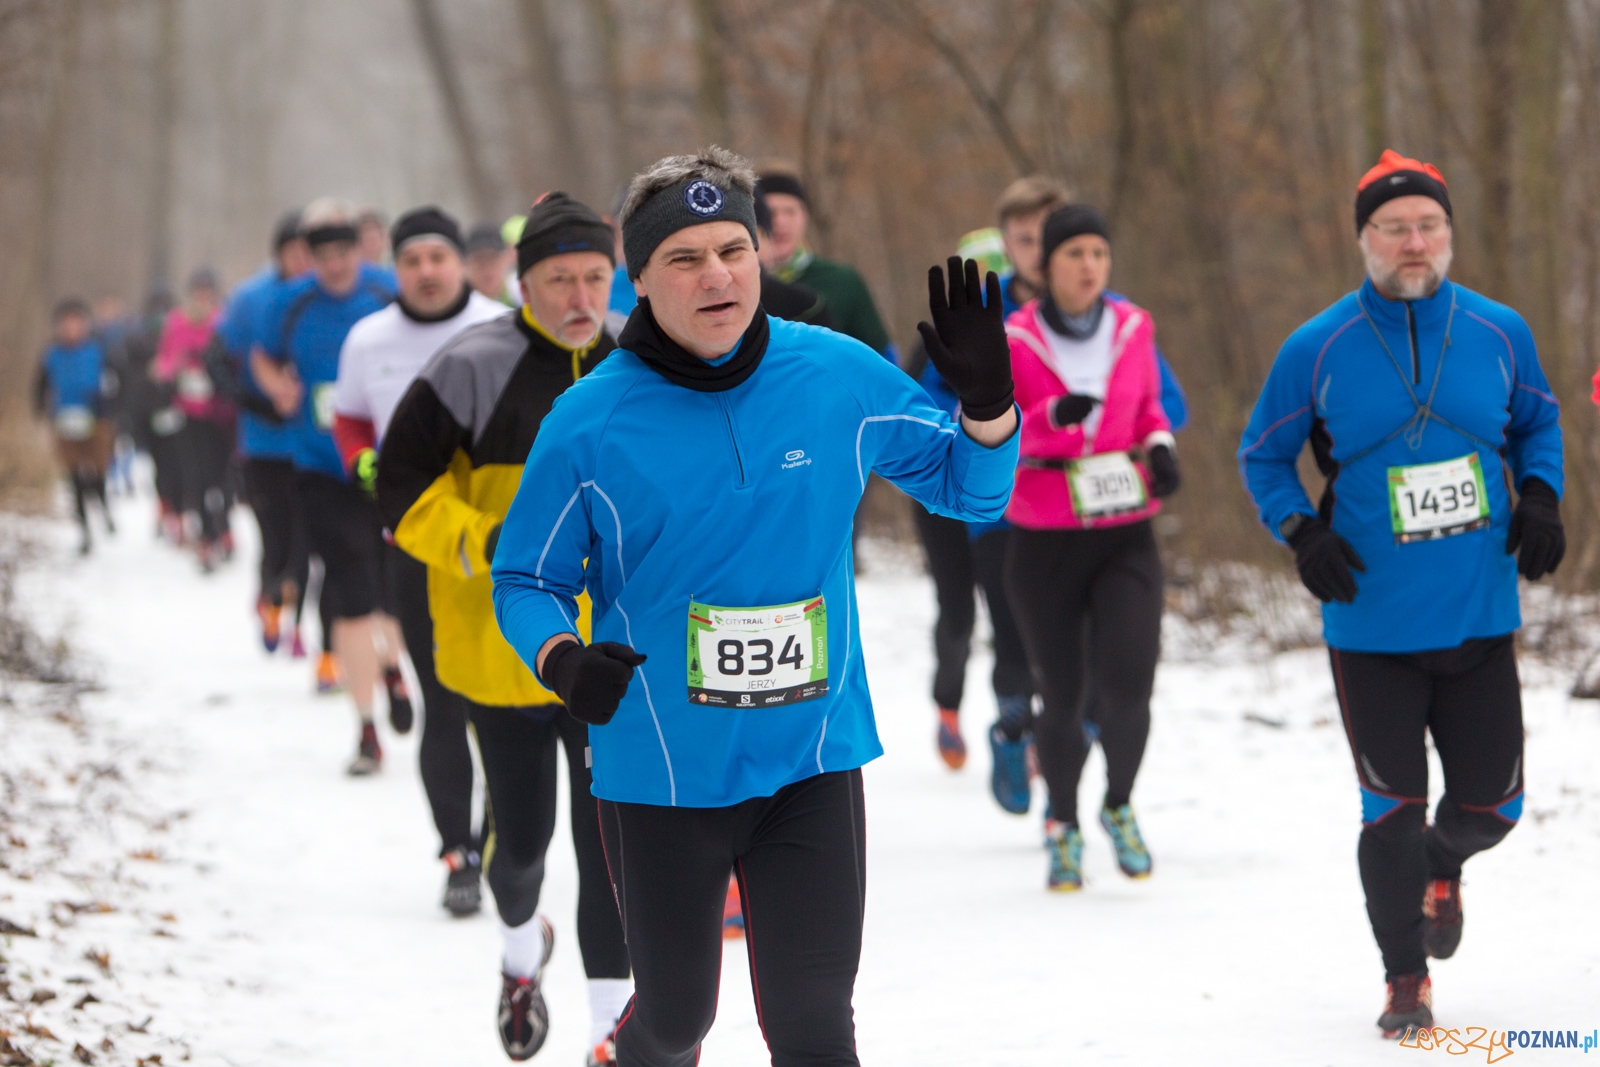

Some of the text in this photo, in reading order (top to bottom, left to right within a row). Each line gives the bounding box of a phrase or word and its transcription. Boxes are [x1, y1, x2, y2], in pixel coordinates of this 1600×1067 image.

[691, 199, 721, 213] SPORTS
[1404, 480, 1477, 517] 1439
[717, 634, 804, 676] 834
[816, 636, 824, 669] Poznań
[746, 678, 777, 690] JERZY
